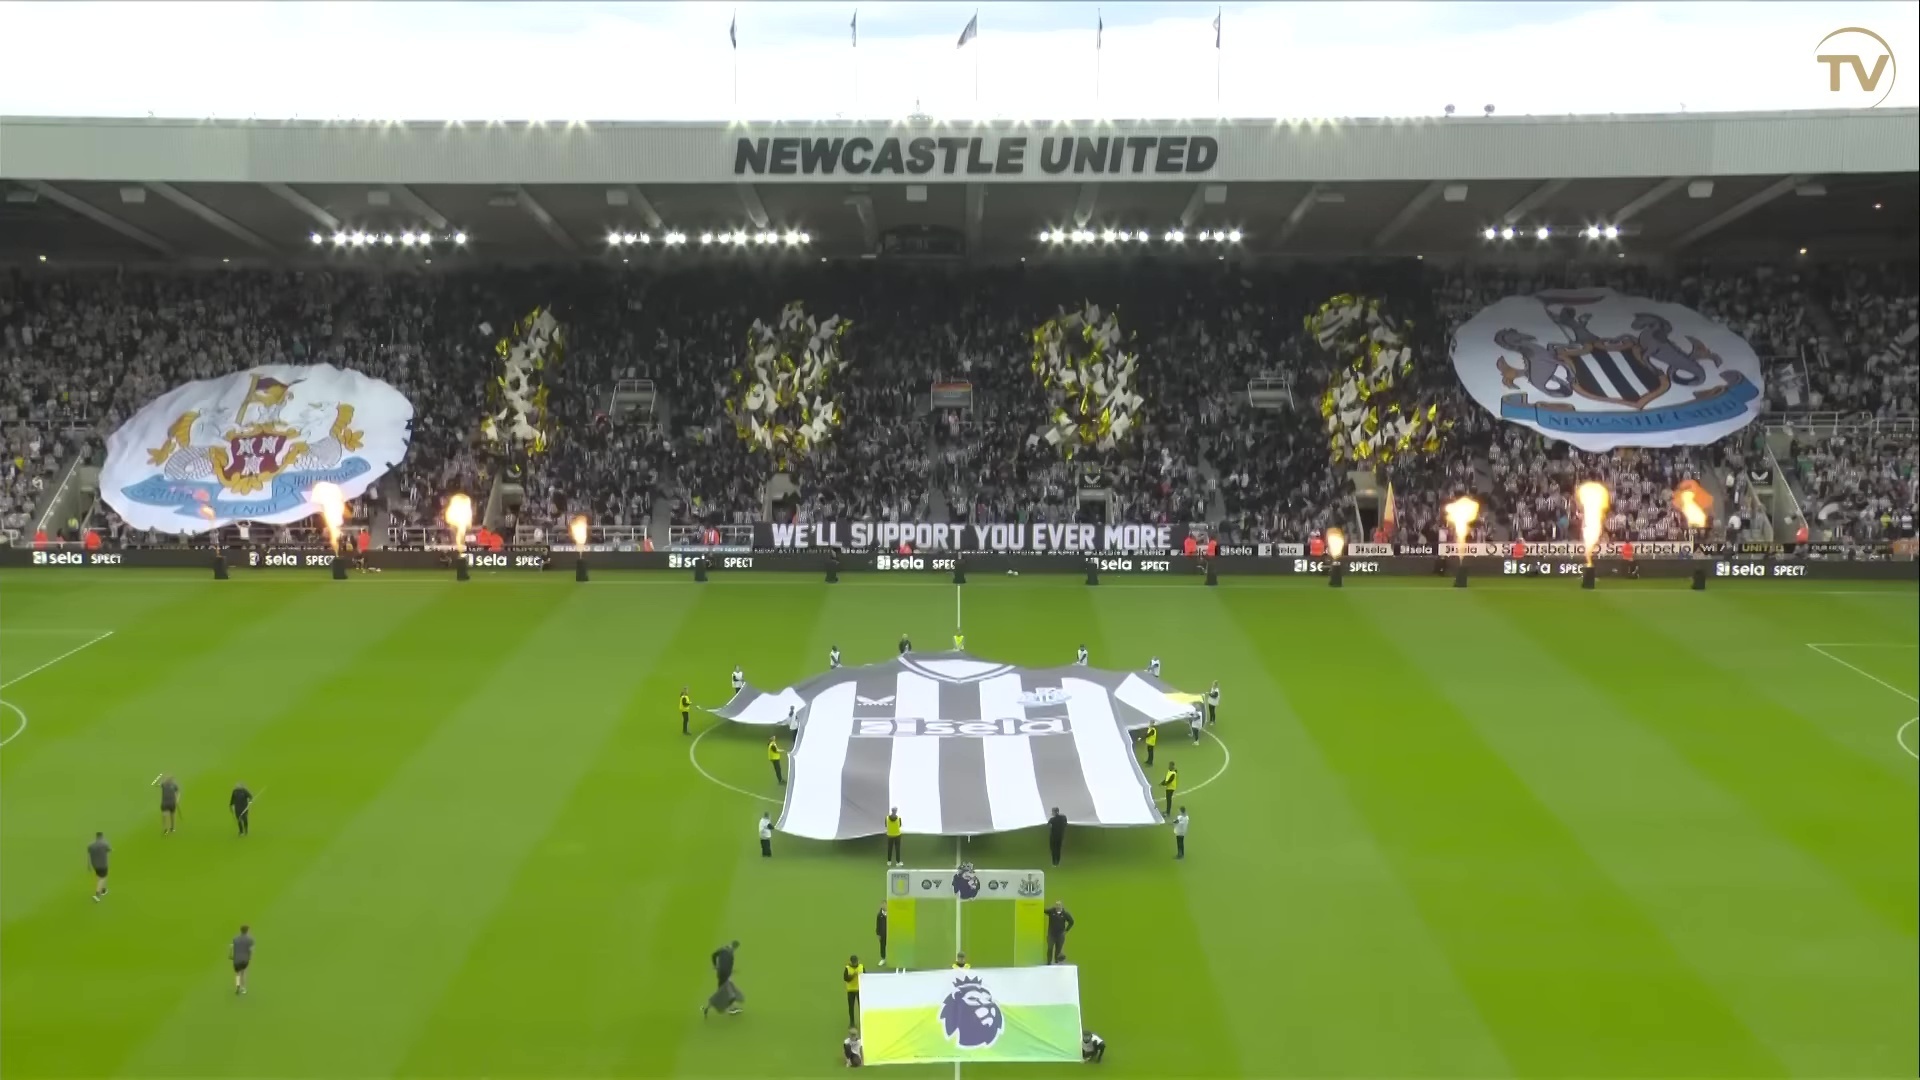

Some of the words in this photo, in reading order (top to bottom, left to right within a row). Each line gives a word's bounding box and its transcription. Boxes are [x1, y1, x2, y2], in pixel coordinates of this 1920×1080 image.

[734, 137, 1027, 174] NEWCASTLE
[1040, 137, 1219, 174] UNITED
[1550, 412, 1664, 426] NEWCASTLE
[772, 522, 843, 547] WE'LL
[851, 523, 965, 550] SUPPORT
[975, 524, 1025, 550] YOU
[1033, 524, 1096, 550] EVER
[1105, 524, 1171, 549] MORE
[1230, 546, 1253, 556] sela
[1365, 546, 1387, 554] sela
[1410, 546, 1433, 555] sela
[1502, 542, 1586, 554] Sortsbet.io
[1606, 542, 1692, 554] Sprtsbet.io
[49, 551, 83, 564] sela
[90, 554, 122, 564] SPECT
[265, 553, 298, 566] sela
[475, 553, 507, 566] sela
[515, 556, 541, 566] SPEC
[724, 557, 753, 568] SPECT
[892, 556, 924, 570] sela
[932, 559, 955, 569] SPEC
[1101, 557, 1133, 570] sela
[1140, 561, 1169, 571] SPECT
[1349, 562, 1379, 572] SPECT
[1560, 563, 1584, 574] SPEC
[1732, 563, 1765, 576] sela
[1774, 565, 1805, 576] SPECT
[923, 718, 1069, 736] sela
